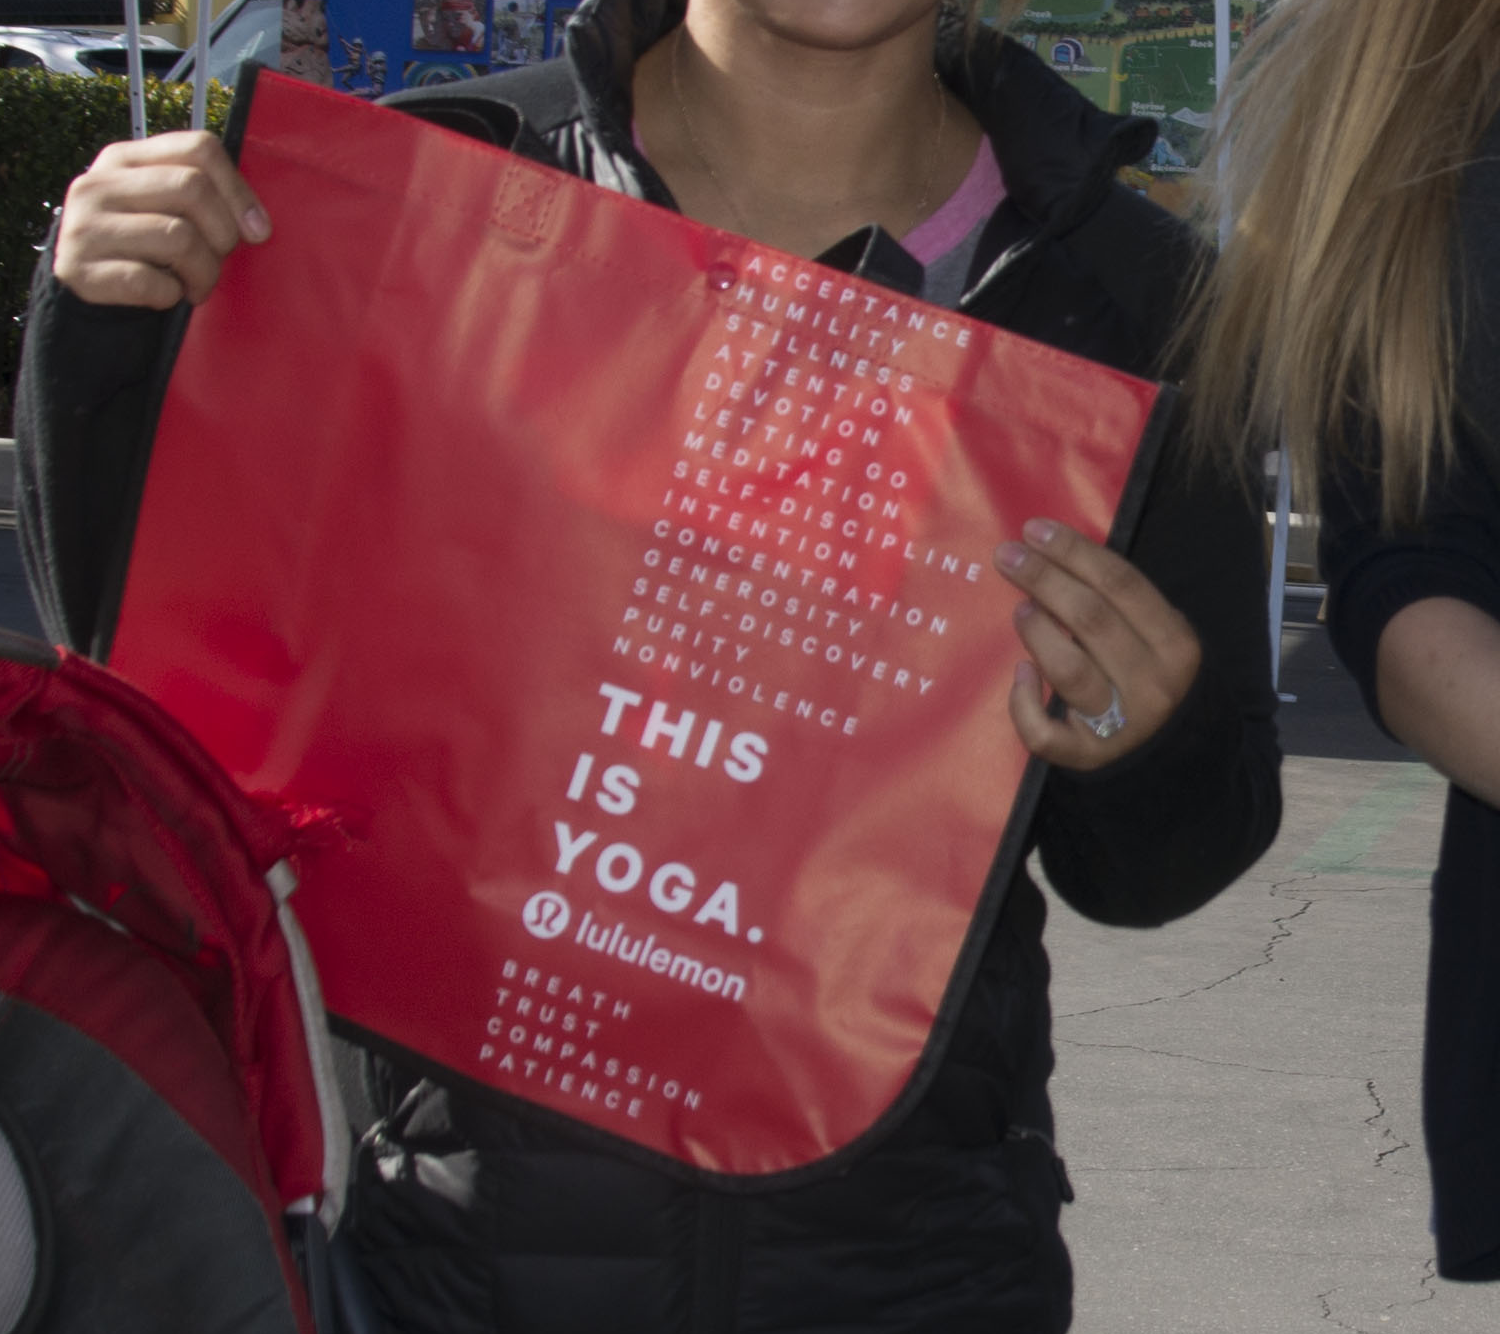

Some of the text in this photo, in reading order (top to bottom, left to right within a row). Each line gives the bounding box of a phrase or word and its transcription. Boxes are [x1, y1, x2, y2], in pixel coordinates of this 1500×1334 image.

[737, 283, 905, 357] HUMILITY
[747, 256, 972, 348] ACCEPTANCE
[714, 343, 913, 426] ATTENTION
[726, 313, 914, 393] STILLNESS
[695, 401, 907, 489] LETTING GO
[705, 372, 881, 447] DEVOTION
[684, 430, 899, 519] MEDITATION
[663, 489, 857, 570] INTENTION
[673, 460, 982, 582] SELF-DISCIPLINE
[644, 548, 863, 637] GENEROSITY
[654, 519, 947, 636] CONCENTRATION
[623, 606, 749, 663] PURITY
[633, 577, 933, 695] SELF-DISCOVERY
[613, 635, 858, 736] NONVIOLENCE
[598, 681, 769, 783] THIS
[565, 751, 641, 815] IS
[554, 820, 764, 945] YOGA.
[502, 959, 631, 1020] BREATH
[575, 911, 747, 1003] lululemon
[496, 987, 601, 1039] TRUST
[479, 1043, 643, 1118] PATIENCE
[487, 1016, 702, 1110] COMPASSION
